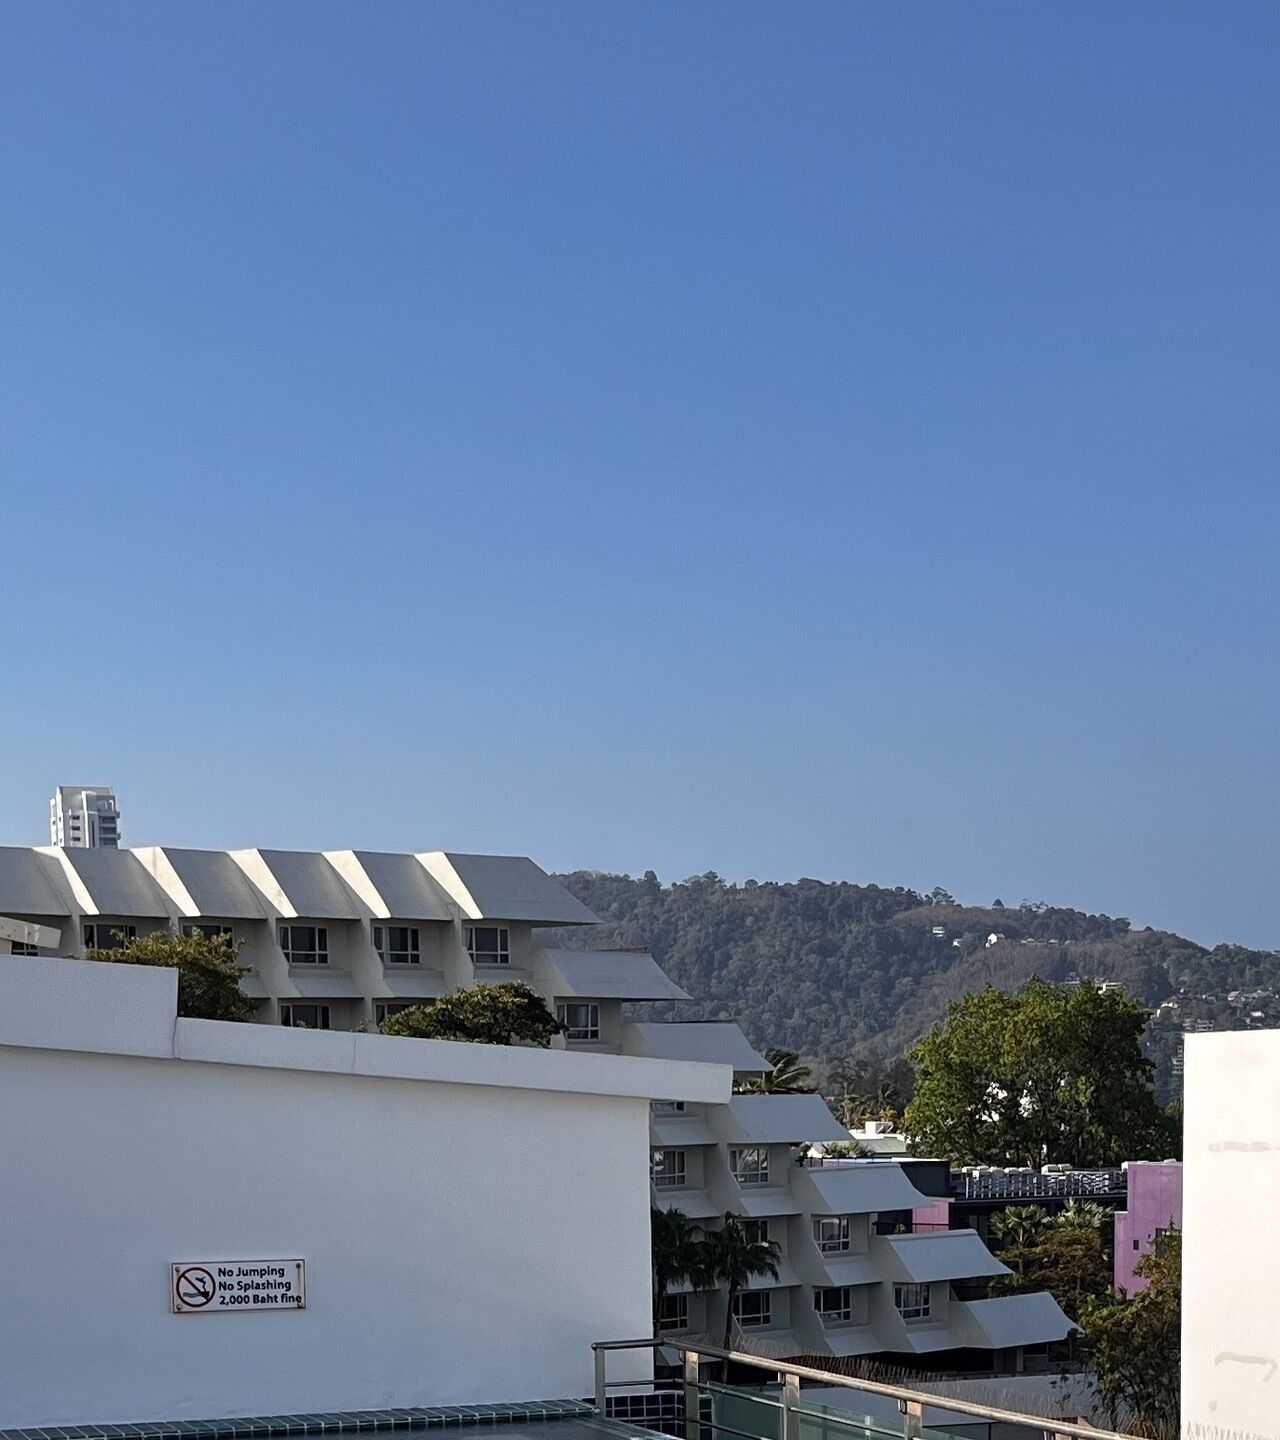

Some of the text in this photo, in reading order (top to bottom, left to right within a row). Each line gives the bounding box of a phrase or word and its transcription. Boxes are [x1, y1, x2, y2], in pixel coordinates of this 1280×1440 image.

[218, 1265, 285, 1278] No Jumping
[219, 1279, 292, 1293] No Splashing
[219, 1292, 303, 1306] 2,000 Baht fine
